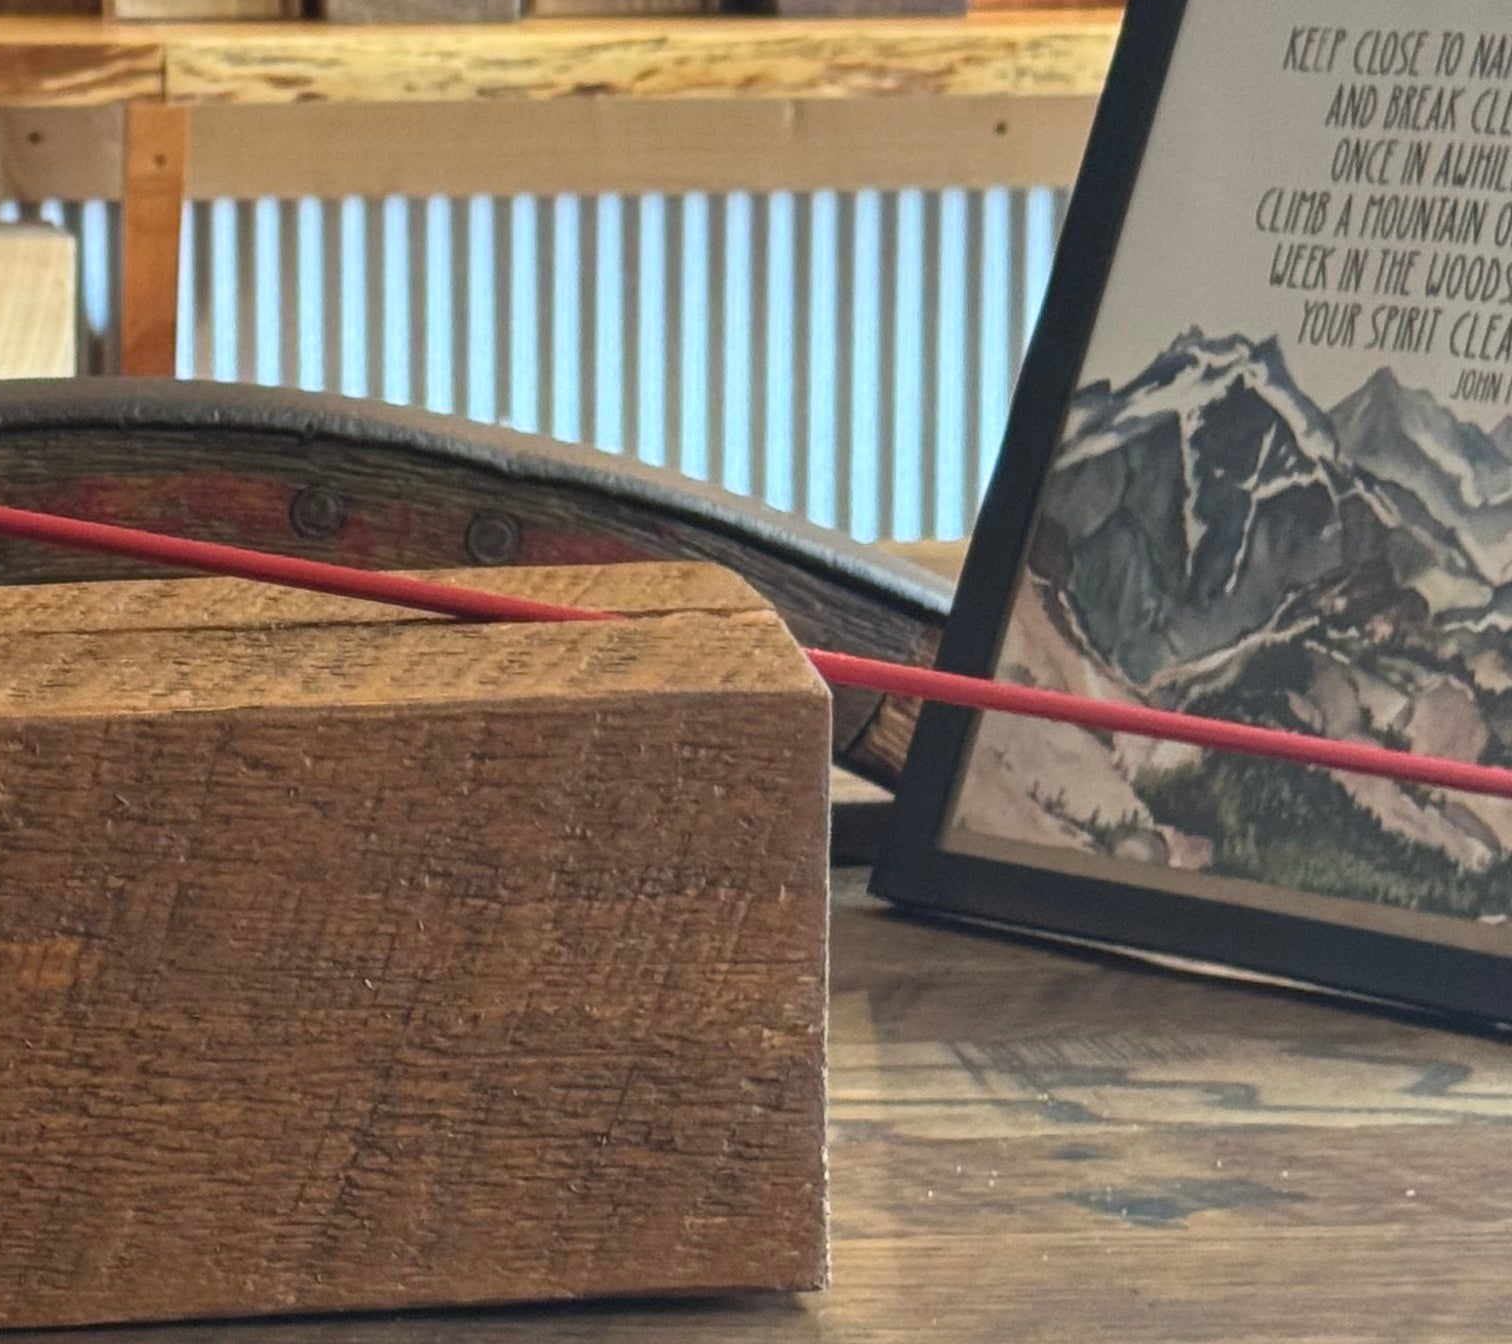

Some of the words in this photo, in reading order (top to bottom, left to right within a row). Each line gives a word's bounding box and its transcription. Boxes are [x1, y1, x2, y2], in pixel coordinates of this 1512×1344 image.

[1283, 26, 1347, 73] KEEP
[1353, 29, 1430, 77] CLOSE
[1435, 31, 1465, 78] TO
[1325, 83, 1378, 130] AND
[1383, 85, 1466, 133] BREAK
[1331, 138, 1399, 185] ONCE
[1400, 141, 1432, 187] IN
[1433, 143, 1512, 194] AWHIL
[1255, 187, 1331, 236] CLIMB
[1335, 194, 1353, 237] A
[1360, 193, 1487, 245] MOUNTAIN
[1495, 202, 1512, 248] O
[1269, 243, 1337, 291] WEEK
[1338, 247, 1369, 293] IN
[1374, 250, 1421, 297] THE
[1298, 299, 1363, 349] YOUR
[1365, 304, 1443, 355] SPIRIT
[1449, 369, 1503, 403] JOHN
